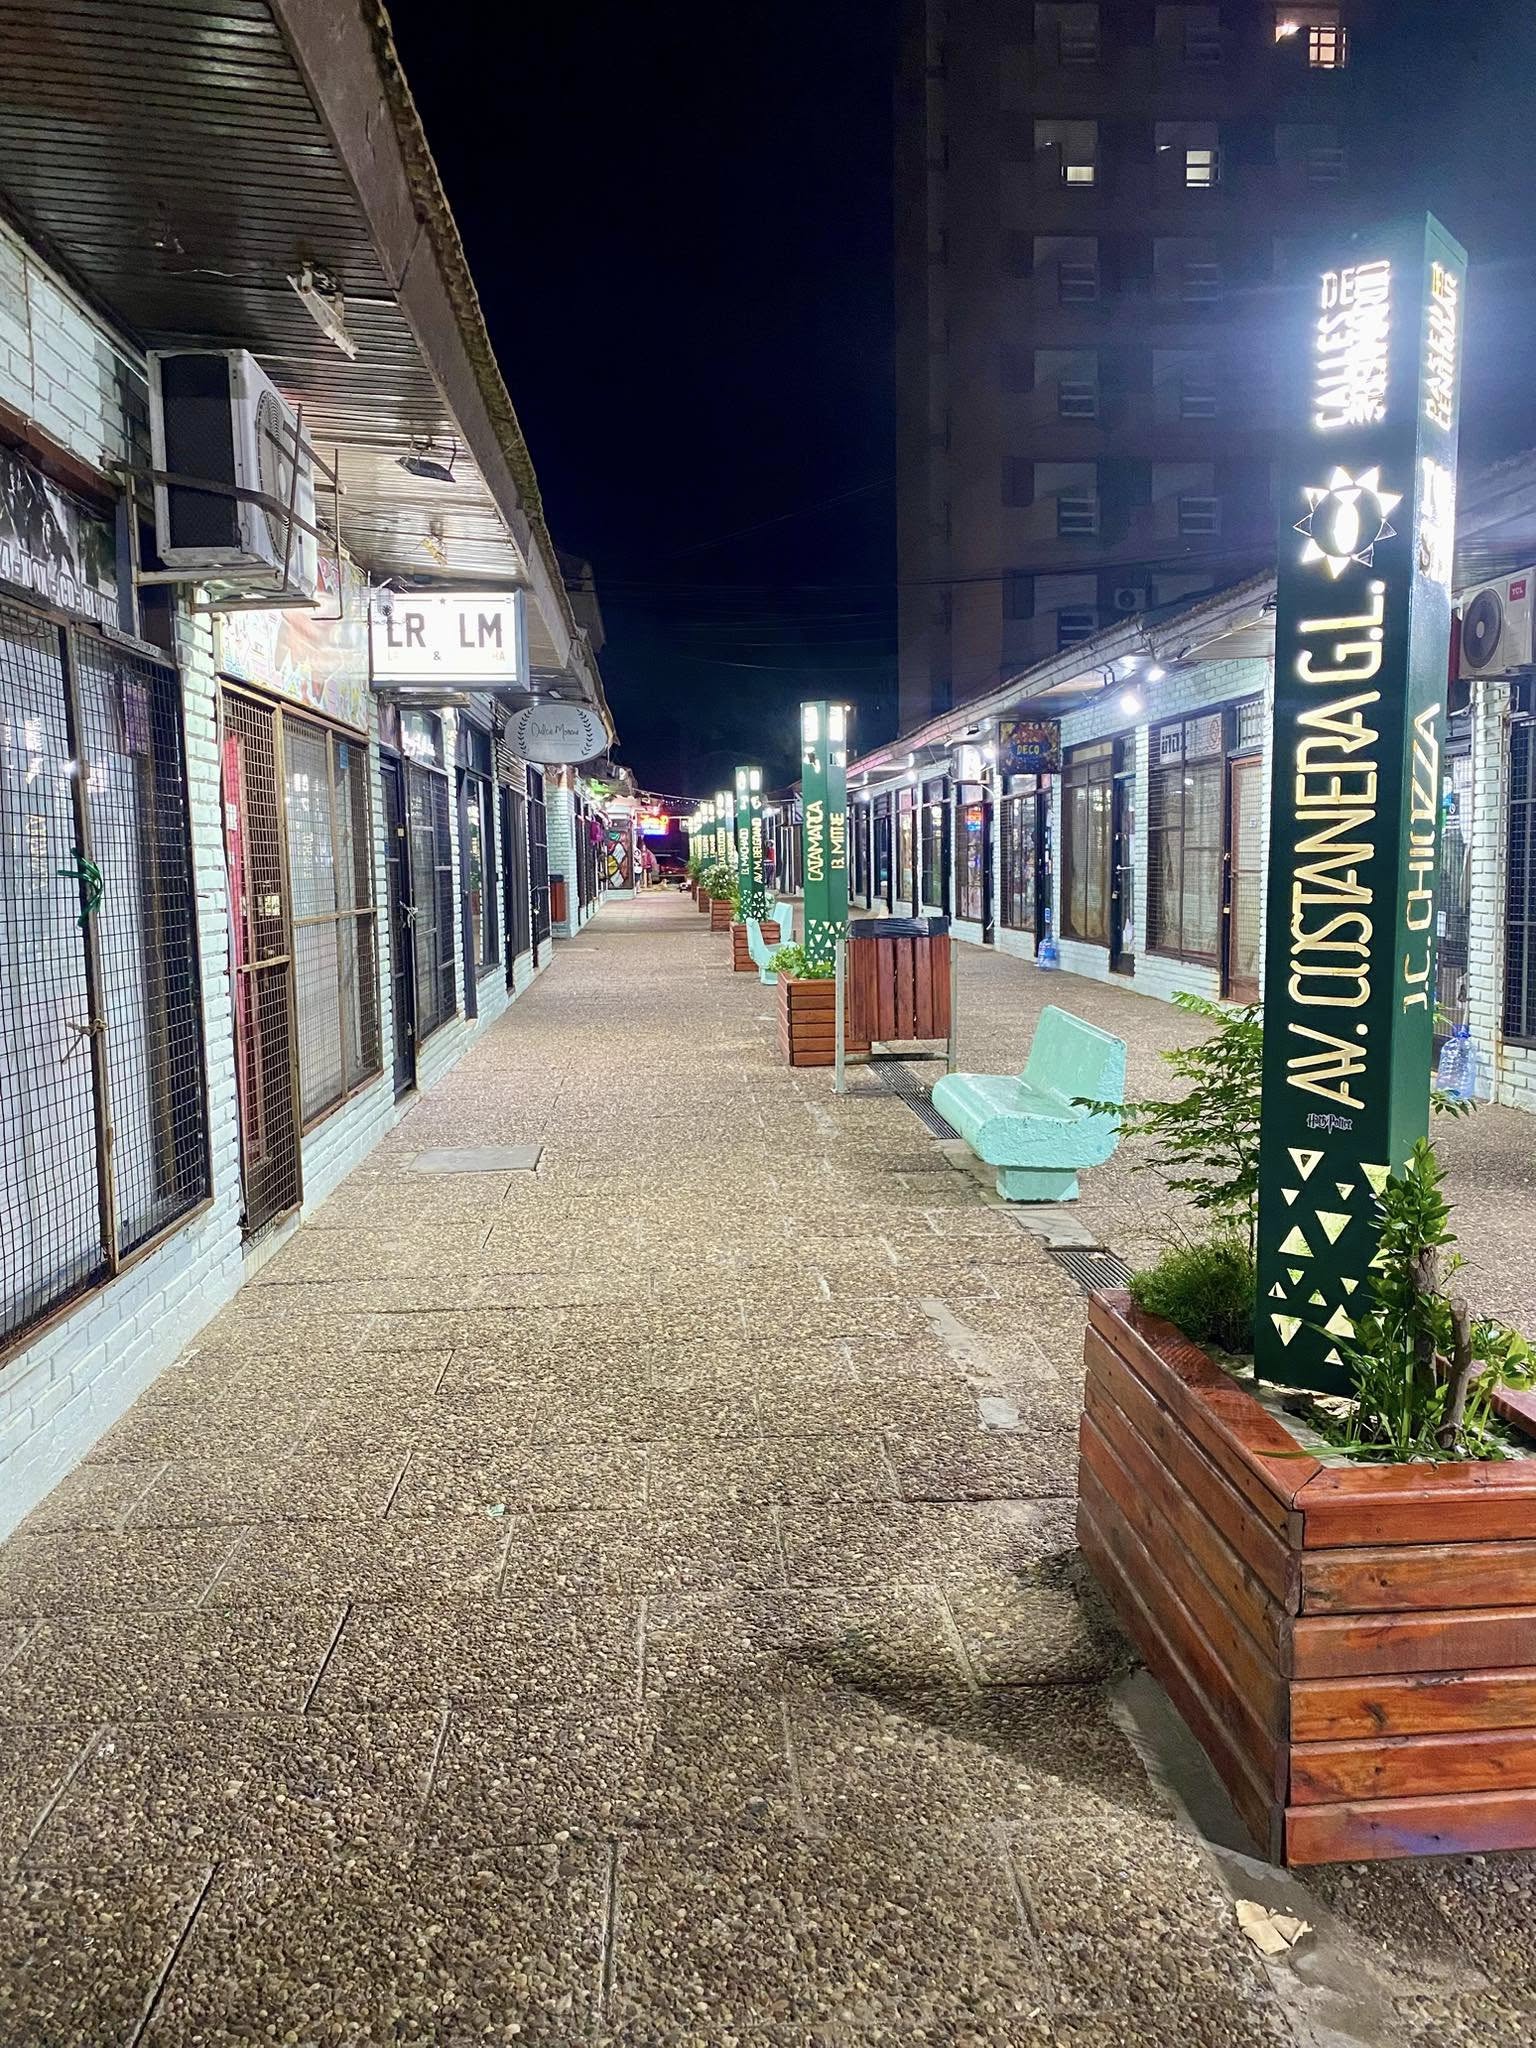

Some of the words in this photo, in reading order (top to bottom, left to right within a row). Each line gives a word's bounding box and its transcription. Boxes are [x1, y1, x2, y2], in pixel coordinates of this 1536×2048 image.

[1313, 310, 1353, 428] CALLES
[59, 574, 75, 609] CD
[1511, 586, 1524, 596] TCL
[386, 612, 427, 648] LR
[458, 612, 503, 648] LM
[1017, 744, 1040, 755] DECO
[830, 812, 845, 854] MITRE
[1405, 702, 1441, 932] CHIOZZA
[806, 800, 825, 881] CATAMARCA
[1288, 690, 1382, 1008] COSTANERA
[1286, 1022, 1368, 1110] AV.
[1306, 1113, 1329, 1128] Harry
[1328, 1113, 1353, 1134] Potter
